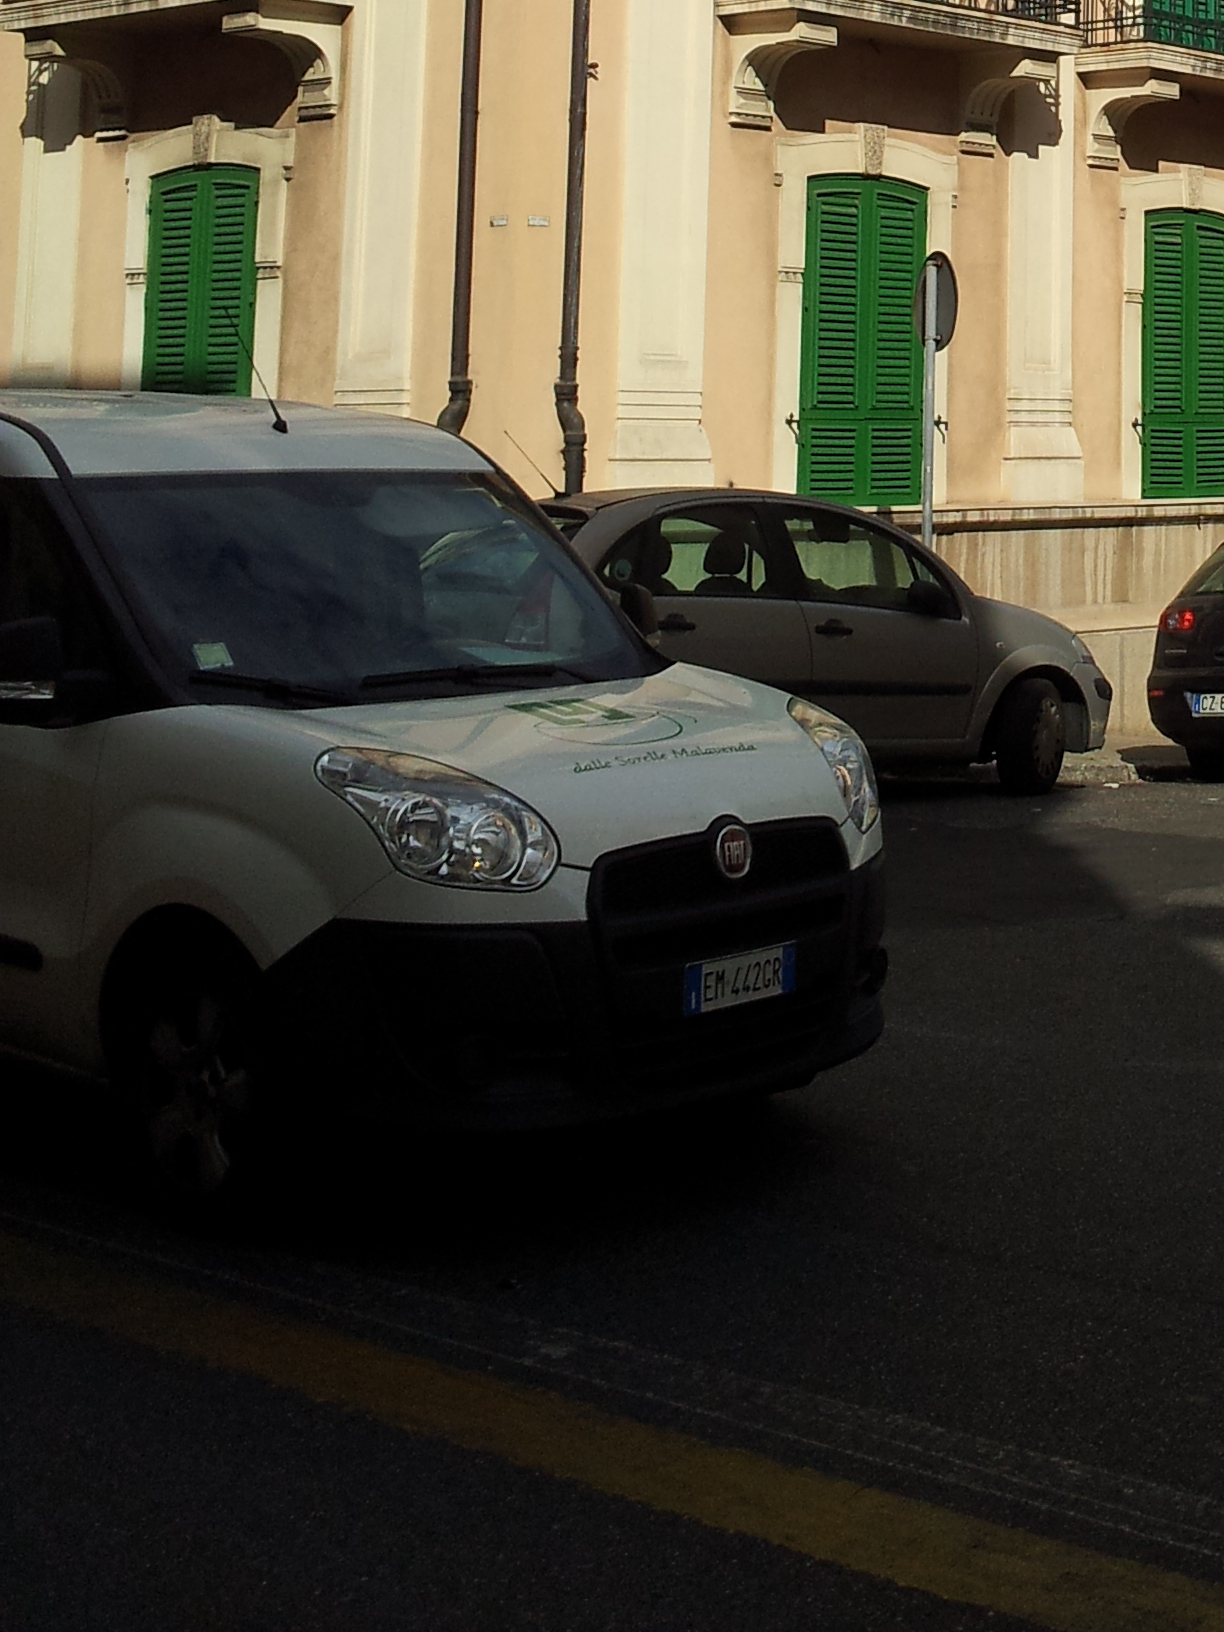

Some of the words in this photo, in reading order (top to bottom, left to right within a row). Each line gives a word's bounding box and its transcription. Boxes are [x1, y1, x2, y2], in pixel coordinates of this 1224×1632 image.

[573, 758, 612, 774] dalle
[614, 751, 668, 767] Sorelle
[723, 840, 746, 865] FIAT
